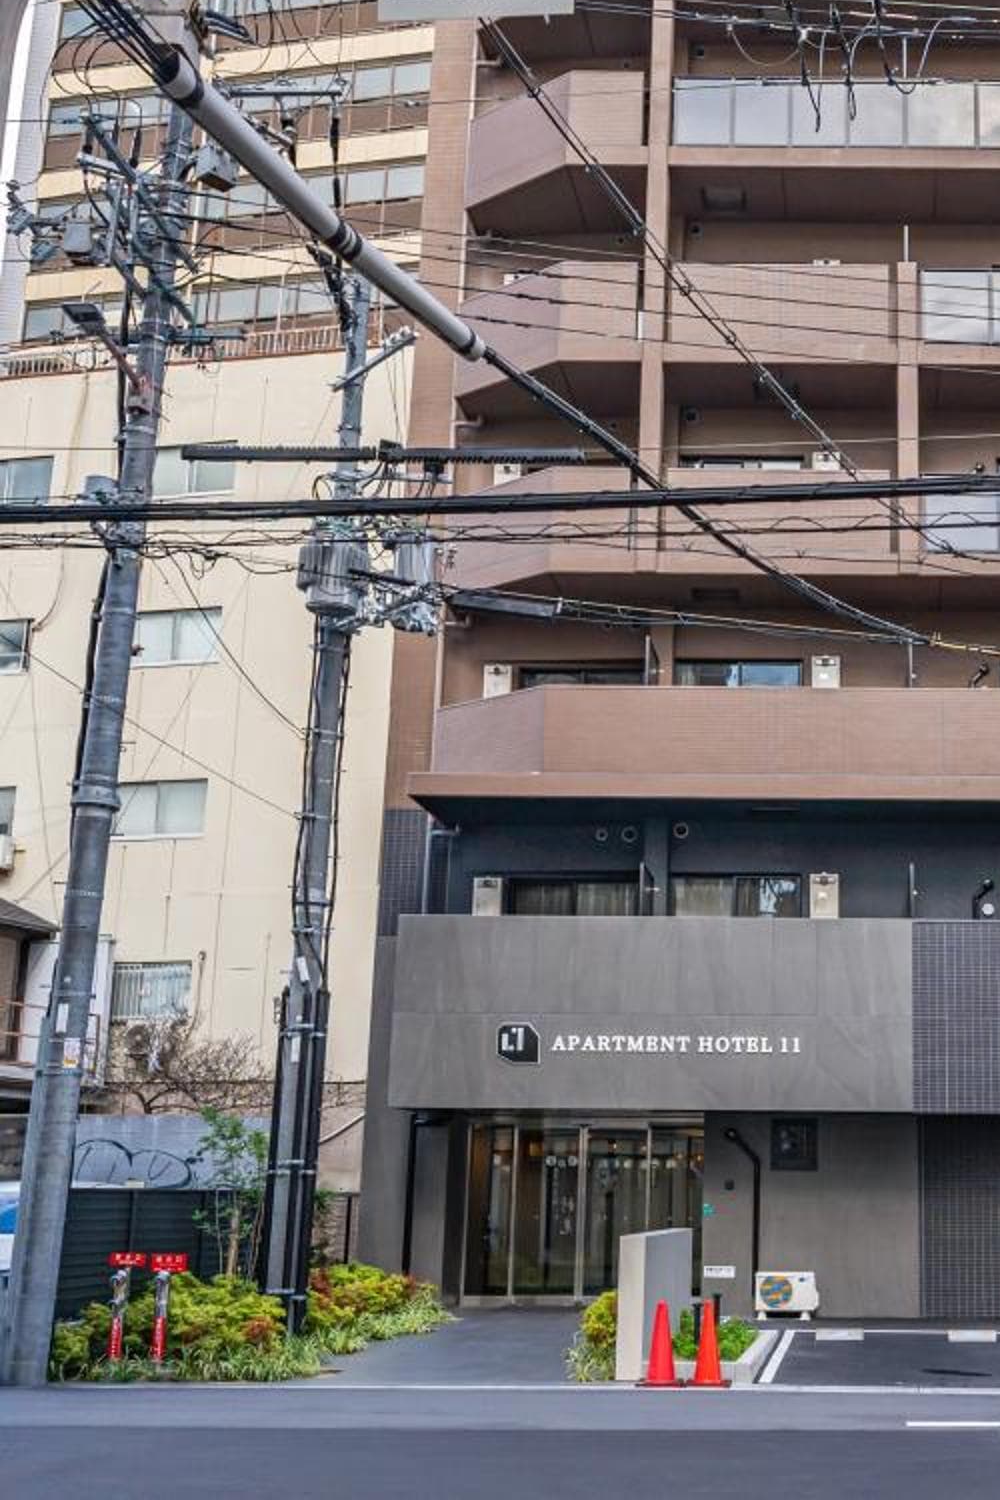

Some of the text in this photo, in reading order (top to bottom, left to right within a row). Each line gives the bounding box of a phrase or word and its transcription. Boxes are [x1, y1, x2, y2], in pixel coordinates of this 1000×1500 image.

[551, 1035, 801, 1053] APARTMENT HOTEL 11
